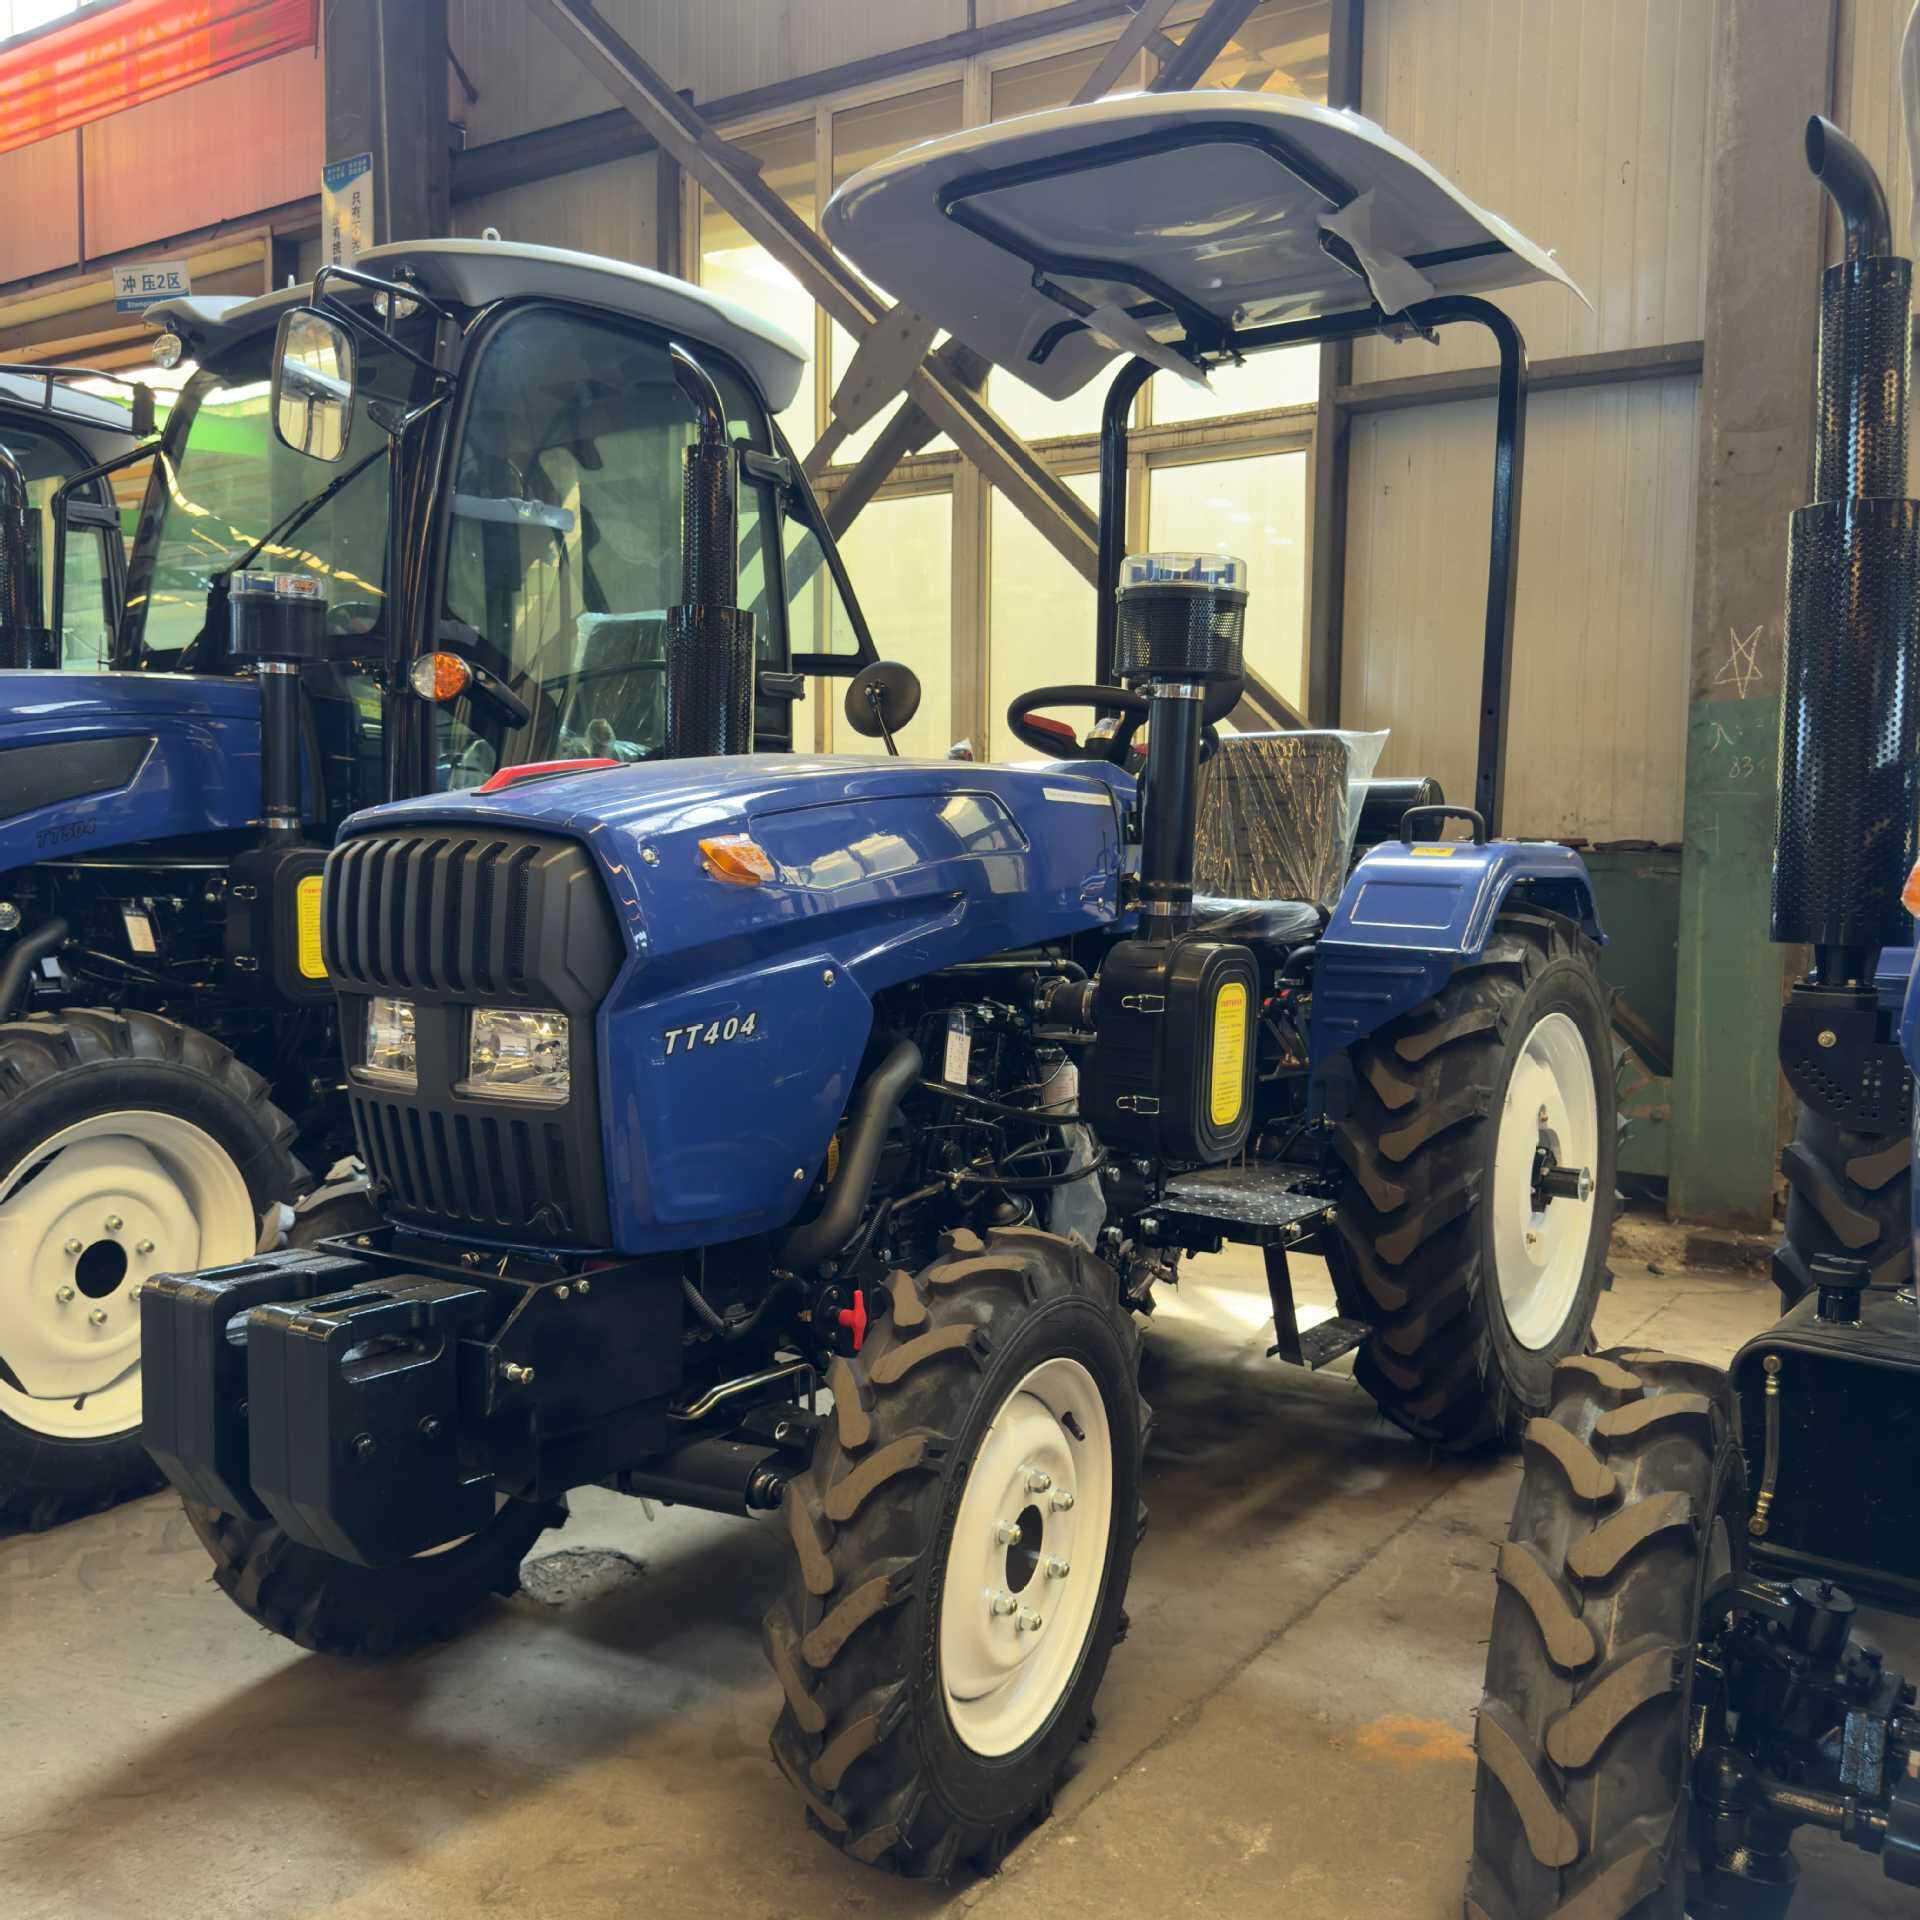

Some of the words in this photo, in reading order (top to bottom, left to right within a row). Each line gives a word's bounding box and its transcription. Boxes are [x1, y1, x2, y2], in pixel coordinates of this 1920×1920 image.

[122, 272, 181, 293] 冲压2区
[664, 1011, 757, 1056] TT404
